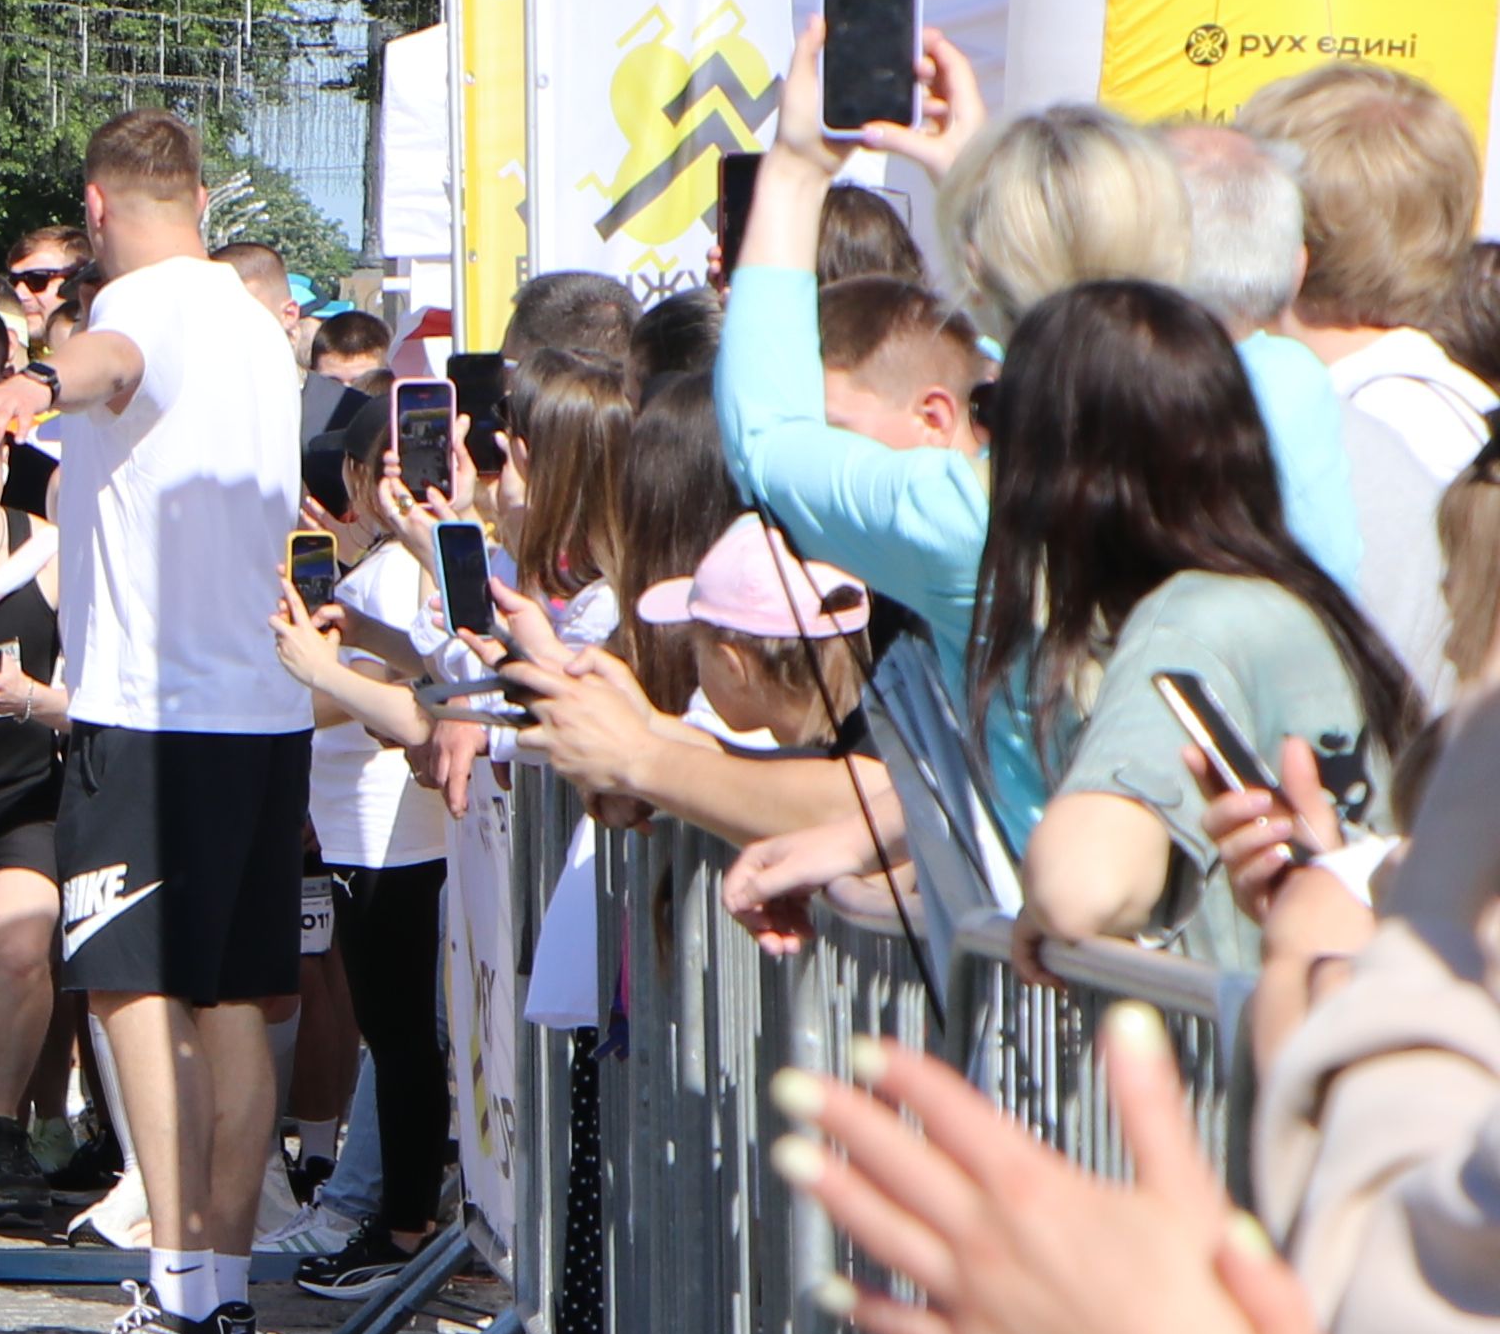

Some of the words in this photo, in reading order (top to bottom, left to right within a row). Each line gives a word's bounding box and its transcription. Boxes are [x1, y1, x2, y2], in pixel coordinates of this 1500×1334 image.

[1239, 34, 1308, 58] рух
[1317, 33, 1418, 59] єдині
[63, 862, 128, 925] NIKE
